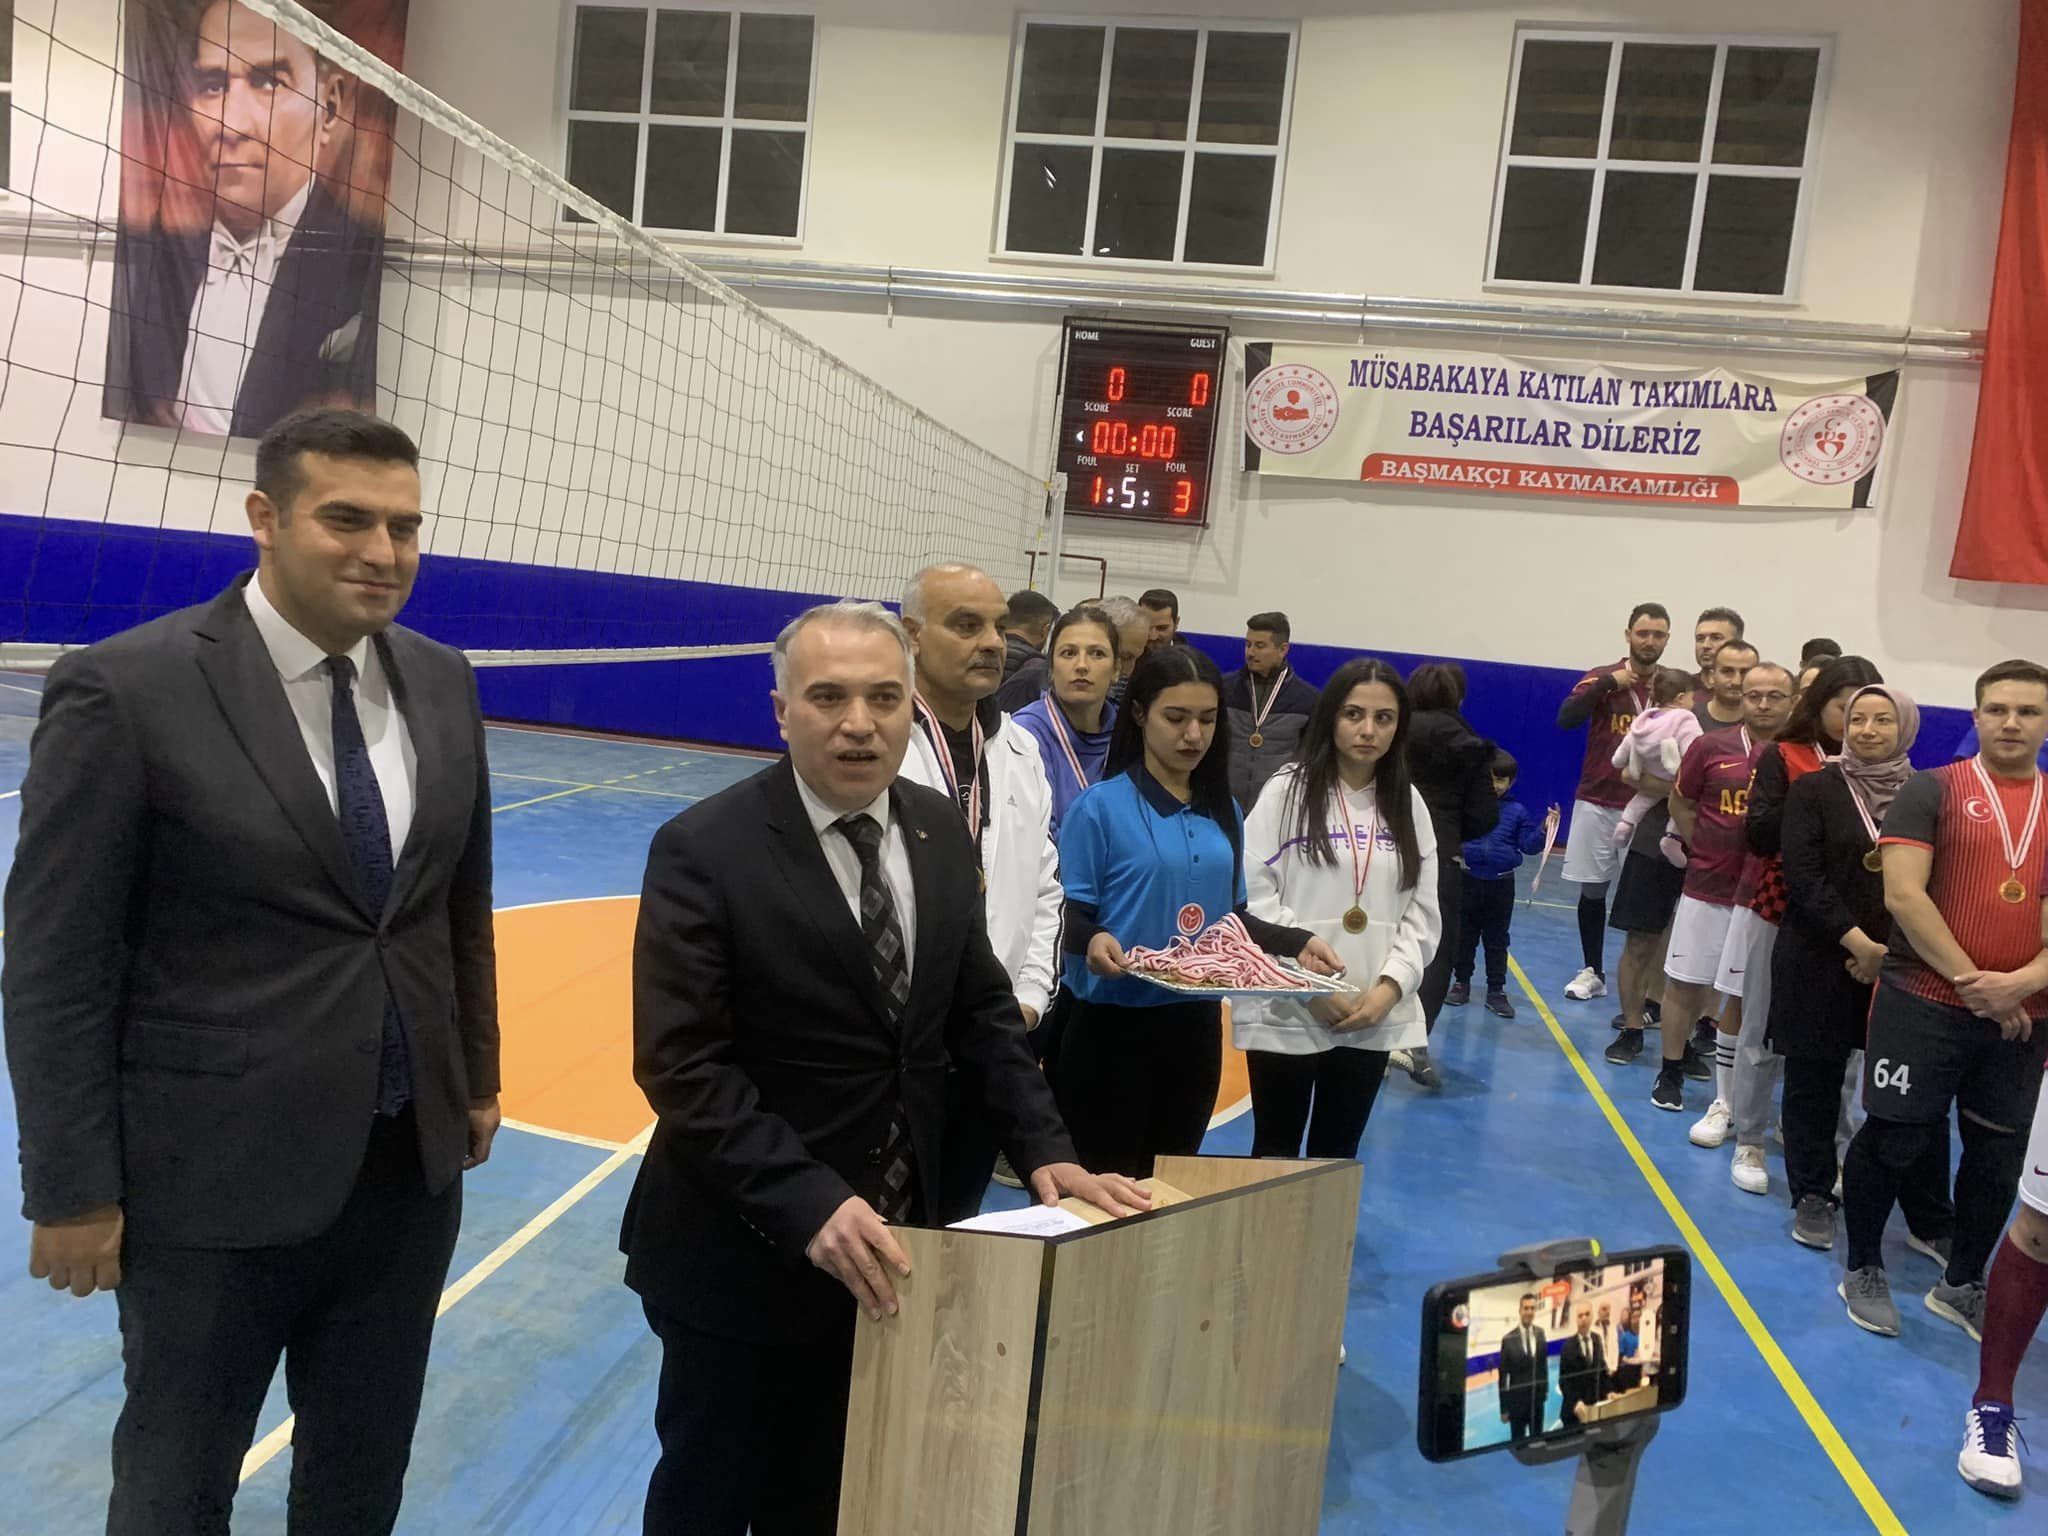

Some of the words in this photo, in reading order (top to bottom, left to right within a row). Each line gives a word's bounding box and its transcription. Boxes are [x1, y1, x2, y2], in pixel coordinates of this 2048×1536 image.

[1075, 330, 1100, 341] HOME
[1190, 338, 1216, 349] GUEST
[1108, 368, 1126, 401] 0
[1191, 373, 1209, 406] 0
[1348, 353, 1510, 397] MÜSABAKAYA
[1517, 370, 1623, 407] KATILAN
[1630, 379, 1778, 412] TAKIMLARA
[1084, 402, 1110, 413] SCORE
[1167, 407, 1193, 418] SCORE
[1093, 421, 1176, 459] 00:00
[1408, 410, 1573, 448] BAŞARILAR
[1581, 417, 1701, 457] DİLERİZ
[1077, 455, 1098, 466] FOUL
[1125, 463, 1140, 474] SET
[1165, 462, 1187, 473] FOUL
[1380, 460, 1511, 486] BAŞMAKÇI
[1518, 470, 1720, 498] KAYMAKAMLIĞI
[1874, 1058, 1912, 1096] 64
